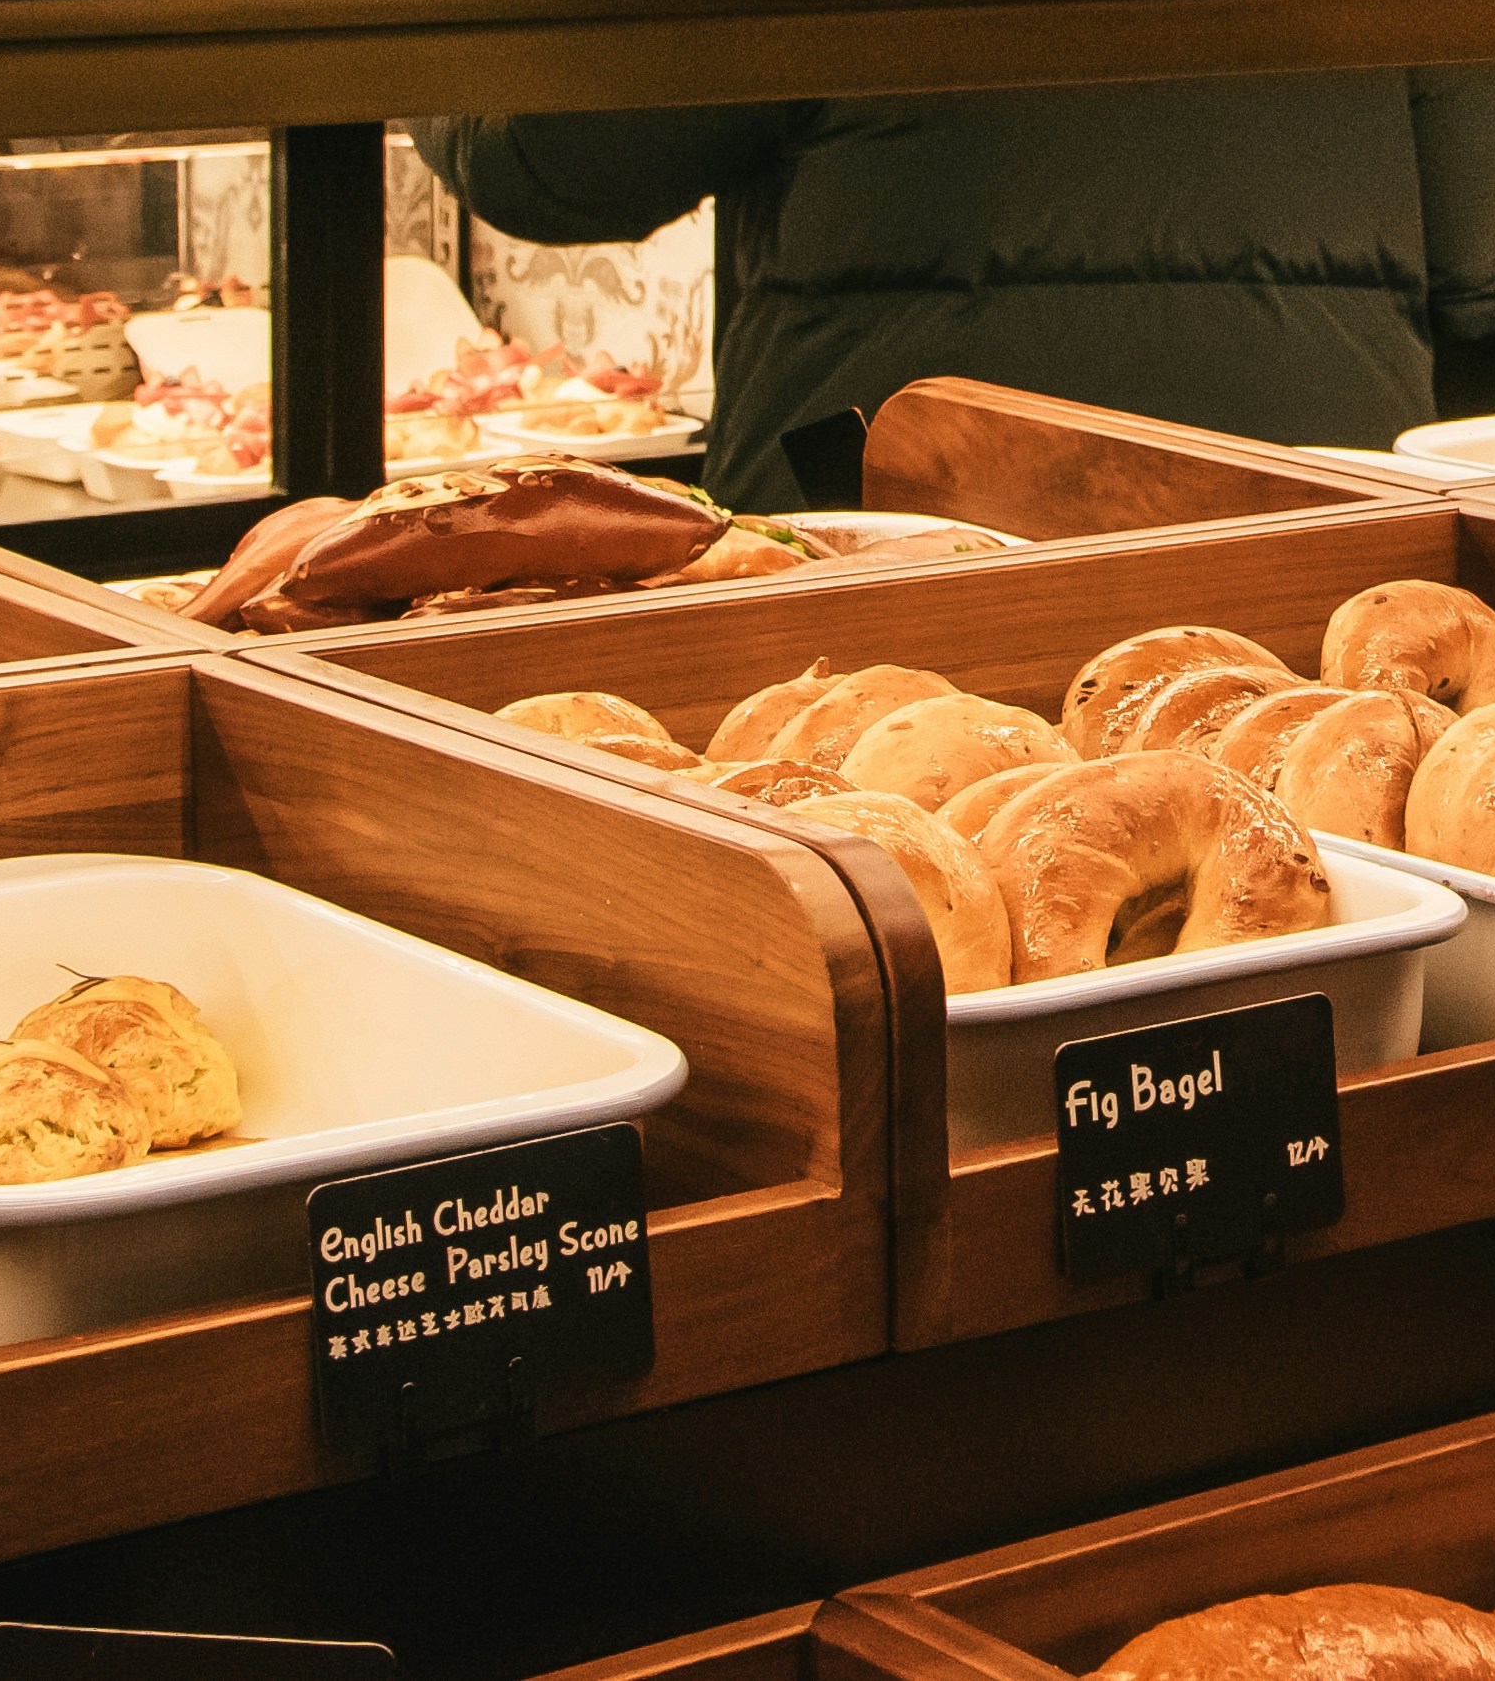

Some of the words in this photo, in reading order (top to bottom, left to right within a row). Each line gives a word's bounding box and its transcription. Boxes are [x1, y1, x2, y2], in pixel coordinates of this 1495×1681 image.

[1065, 1080, 1120, 1130] Fig
[1130, 1050, 1224, 1113] Bagel
[320, 1210, 423, 1264] English
[433, 1185, 551, 1237] Cheddar
[325, 1271, 427, 1313] Cheese
[447, 1235, 549, 1286] Parsley
[559, 1220, 640, 1257] Scone
